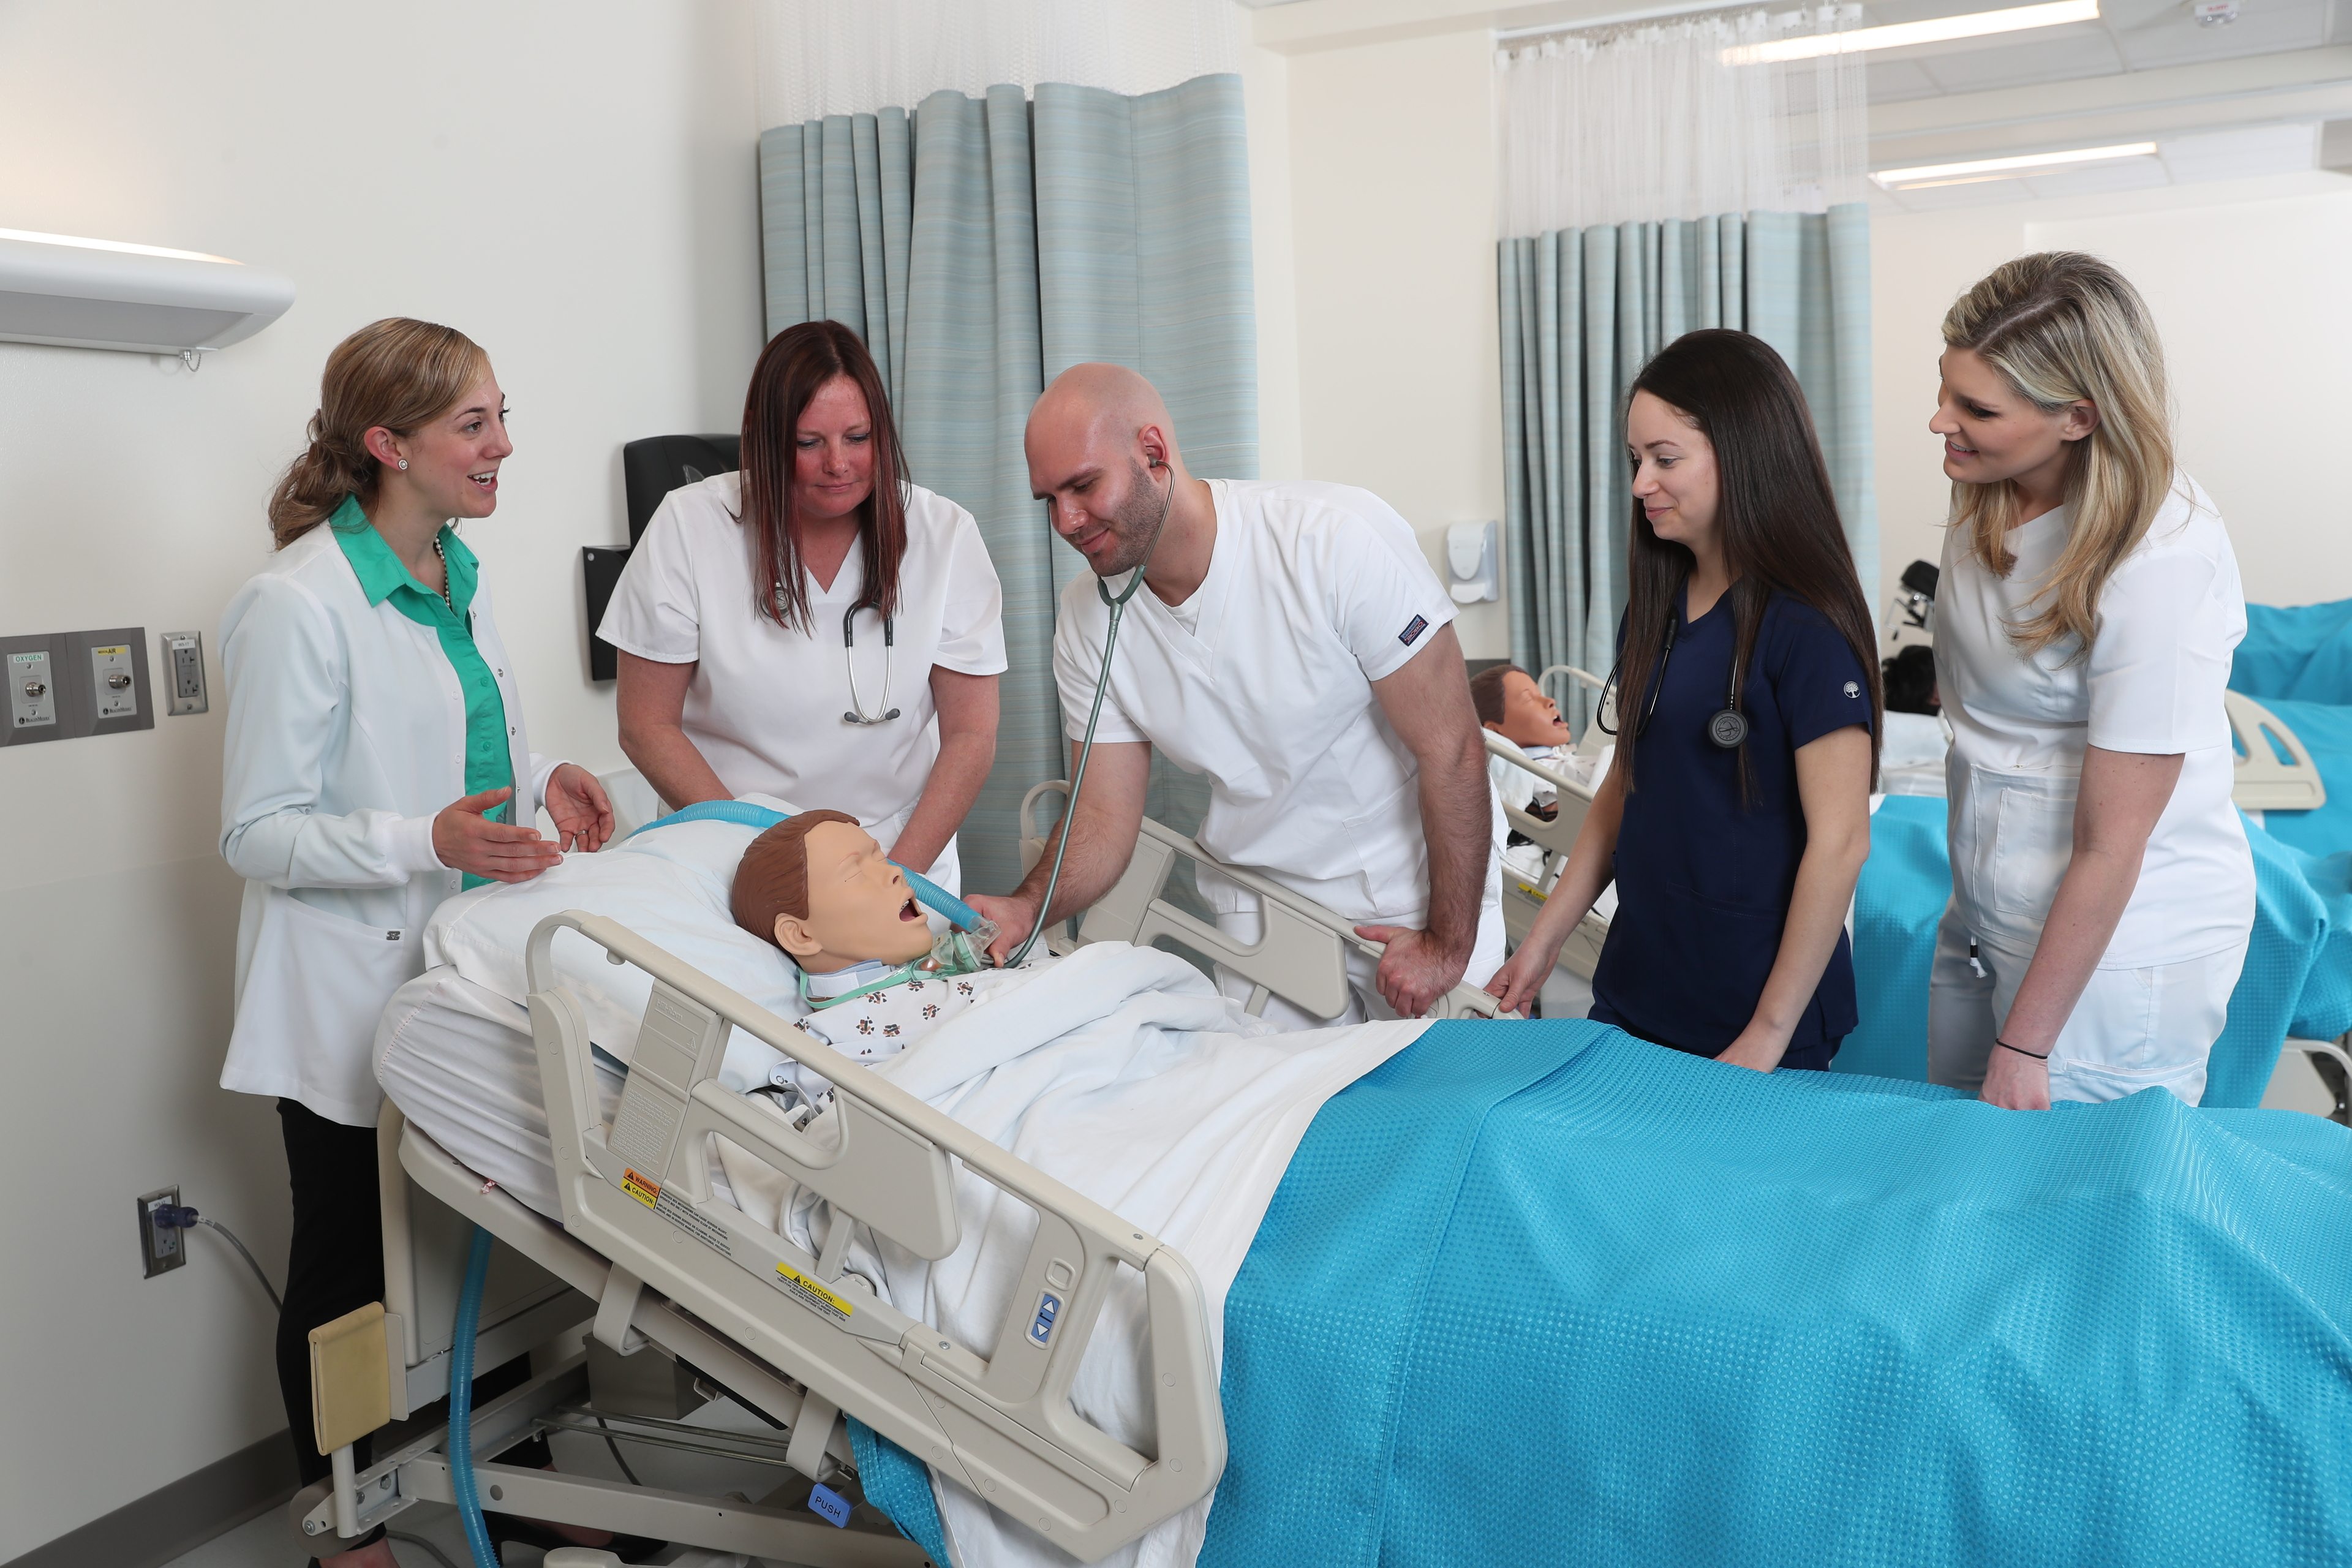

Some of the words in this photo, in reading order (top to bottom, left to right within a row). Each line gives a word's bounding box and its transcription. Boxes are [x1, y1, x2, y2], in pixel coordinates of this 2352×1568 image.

[635, 1176, 657, 1194] WARNING:
[631, 1187, 654, 1205] CAUTION:
[803, 1281, 835, 1304] CAUTION:
[815, 1496, 841, 1518] PUSH
